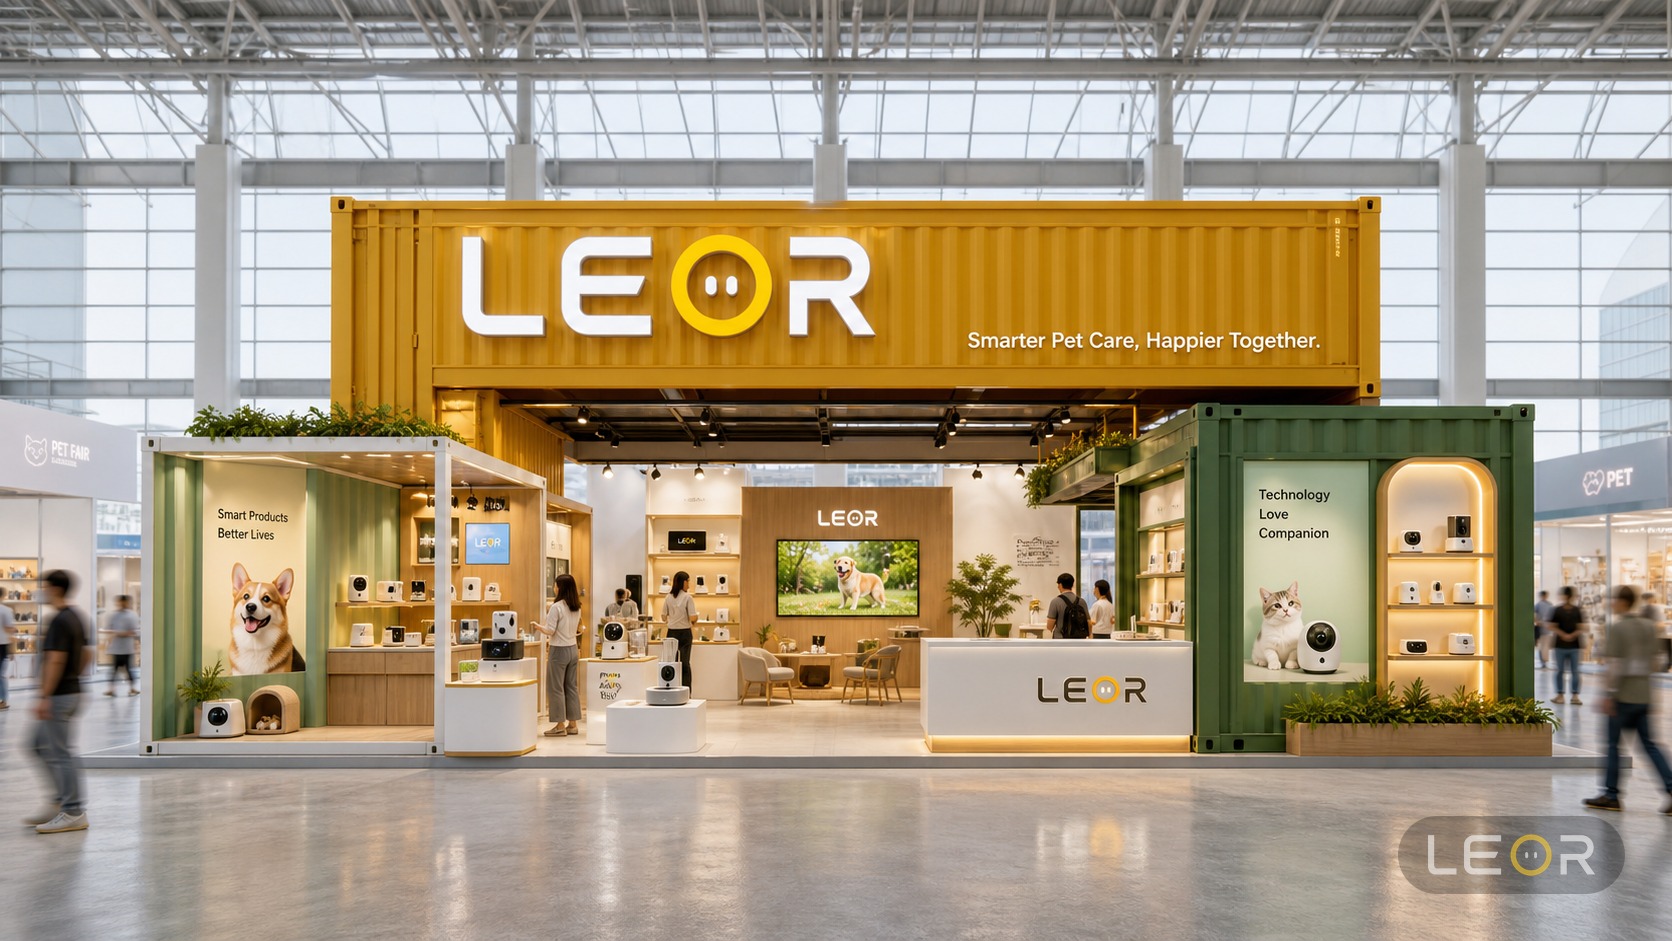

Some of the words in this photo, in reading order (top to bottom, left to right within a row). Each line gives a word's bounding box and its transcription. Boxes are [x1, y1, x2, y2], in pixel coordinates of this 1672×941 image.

[461, 234, 875, 337] LEOR
[967, 331, 1046, 349] Smarter
[1052, 331, 1083, 349] Pet
[1089, 331, 1139, 352] Care,
[1146, 331, 1225, 353] Happier
[1229, 331, 1321, 353] Together.
[51, 439, 69, 458] PET
[70, 443, 90, 462] FAIR
[1606, 467, 1634, 489] PET
[1258, 488, 1331, 503] Technology
[217, 508, 247, 521] Smart
[249, 510, 289, 523] Products
[817, 509, 879, 527] LEOR
[1259, 508, 1289, 520] Love
[217, 527, 249, 539] Better
[250, 528, 275, 541] Lives
[1258, 527, 1329, 541] Companion
[1037, 675, 1147, 704] LEOR
